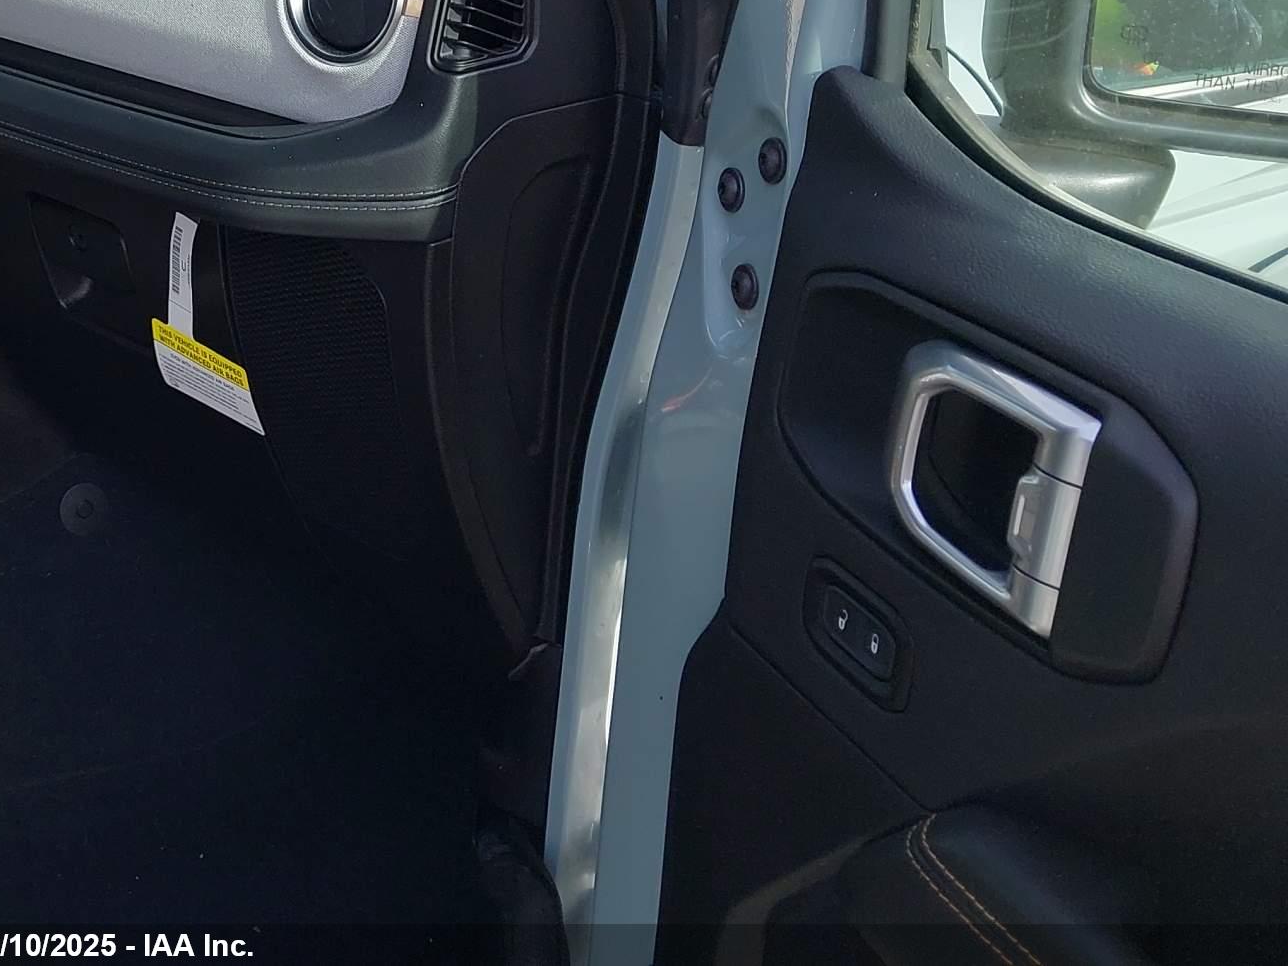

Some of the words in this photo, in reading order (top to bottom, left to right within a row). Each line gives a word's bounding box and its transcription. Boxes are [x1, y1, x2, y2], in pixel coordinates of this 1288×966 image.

[1195, 73, 1235, 90] THAN
[159, 325, 172, 337] THIS
[174, 333, 200, 354] VEHICLE
[201, 349, 208, 359] IS
[209, 352, 243, 378] EQUIPPED
[159, 336, 176, 349] WITH
[177, 344, 211, 368] ADVANCED
[213, 365, 225, 376] AIR
[226, 372, 244, 387] BAGS
